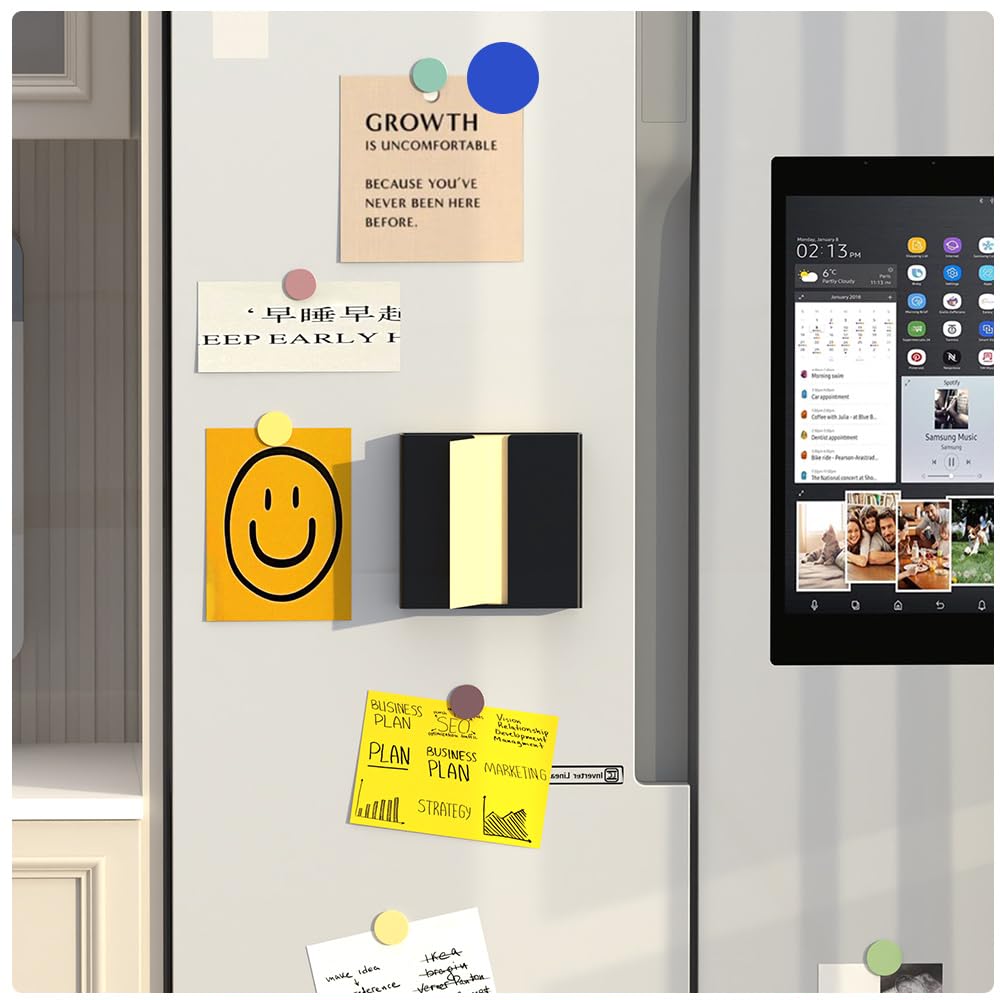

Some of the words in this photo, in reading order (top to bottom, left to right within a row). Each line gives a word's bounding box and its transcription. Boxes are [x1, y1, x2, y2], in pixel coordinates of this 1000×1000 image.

[365, 112, 478, 132] GROWTH
[365, 140, 377, 151] IS
[381, 140, 498, 151] UNCOMFORTABLE
[365, 178, 423, 189] BECAUSE
[365, 198, 407, 208] NEVER
[411, 198, 444, 208] BEEN
[448, 198, 480, 208] HERE
[365, 217, 418, 228] BEFORE.
[796, 243, 848, 259] 02:13
[198, 334, 260, 346] EEP
[269, 332, 378, 345] EARLY
[943, 379, 960, 387] Spotify
[925, 433, 957, 443] Samsung
[958, 432, 978, 441] Music
[370, 699, 423, 718] BUSINESS
[374, 713, 411, 730] PLAN
[437, 716, 471, 734] SEO
[496, 714, 522, 725] Vision
[495, 728, 547, 743] Development
[497, 721, 549, 738] Relationship
[368, 741, 410, 765] PLAN
[426, 746, 478, 763] BUSINESS
[428, 760, 470, 782] PLAN
[484, 762, 547, 781] MARKETING
[417, 799, 472, 820] STRATEGY
[358, 965, 381, 975] idea
